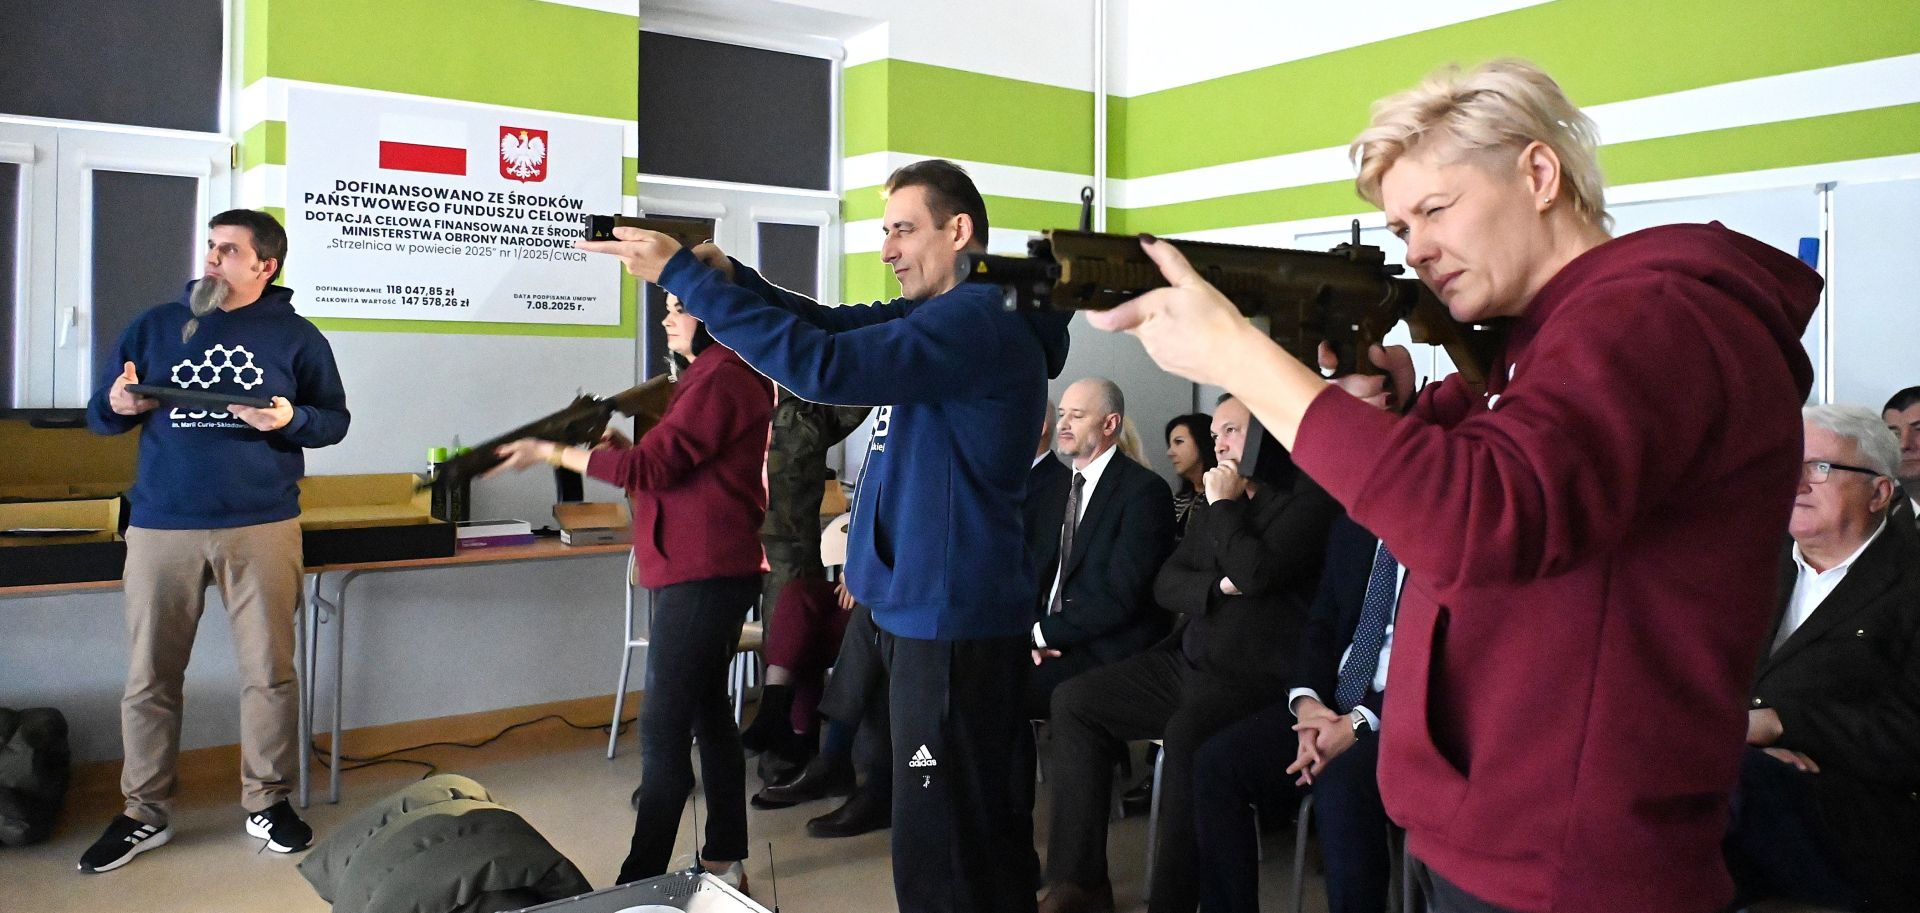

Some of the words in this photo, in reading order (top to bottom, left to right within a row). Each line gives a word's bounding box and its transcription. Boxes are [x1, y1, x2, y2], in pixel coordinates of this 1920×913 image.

[335, 179, 483, 201] DOFINANSOWANO
[487, 192, 505, 204] ZE
[508, 191, 583, 210] ŚRODKÓW
[304, 191, 440, 213] PAŃSTWOWEGO
[444, 203, 524, 220] FUNDUSZU
[528, 210, 586, 224] CELOWE
[305, 211, 372, 225] DOTACJA
[375, 215, 431, 229] CELOWA
[434, 219, 528, 235] FINANSOWANA
[531, 226, 545, 236] ZE
[547, 224, 586, 239] ŚRODK
[342, 225, 442, 241] MINISTERSTWA
[445, 232, 497, 244] OBRONY
[500, 236, 576, 249] NARODOWEJ
[327, 238, 392, 251] „Strzelnica
[395, 244, 406, 252] w
[408, 244, 462, 256] powiecie
[499, 250, 511, 258] nr
[514, 247, 587, 262] 1/2025/CWCR
[315, 286, 382, 294] DOFINANSOWANIE
[387, 285, 402, 295] 118
[405, 286, 443, 297] 047,85
[445, 288, 455, 297] zł
[402, 296, 419, 305] 147
[422, 297, 458, 307] 578,26
[460, 298, 470, 307] zł
[526, 301, 576, 311] 7.08.2025
[908, 759, 937, 768] adidas
